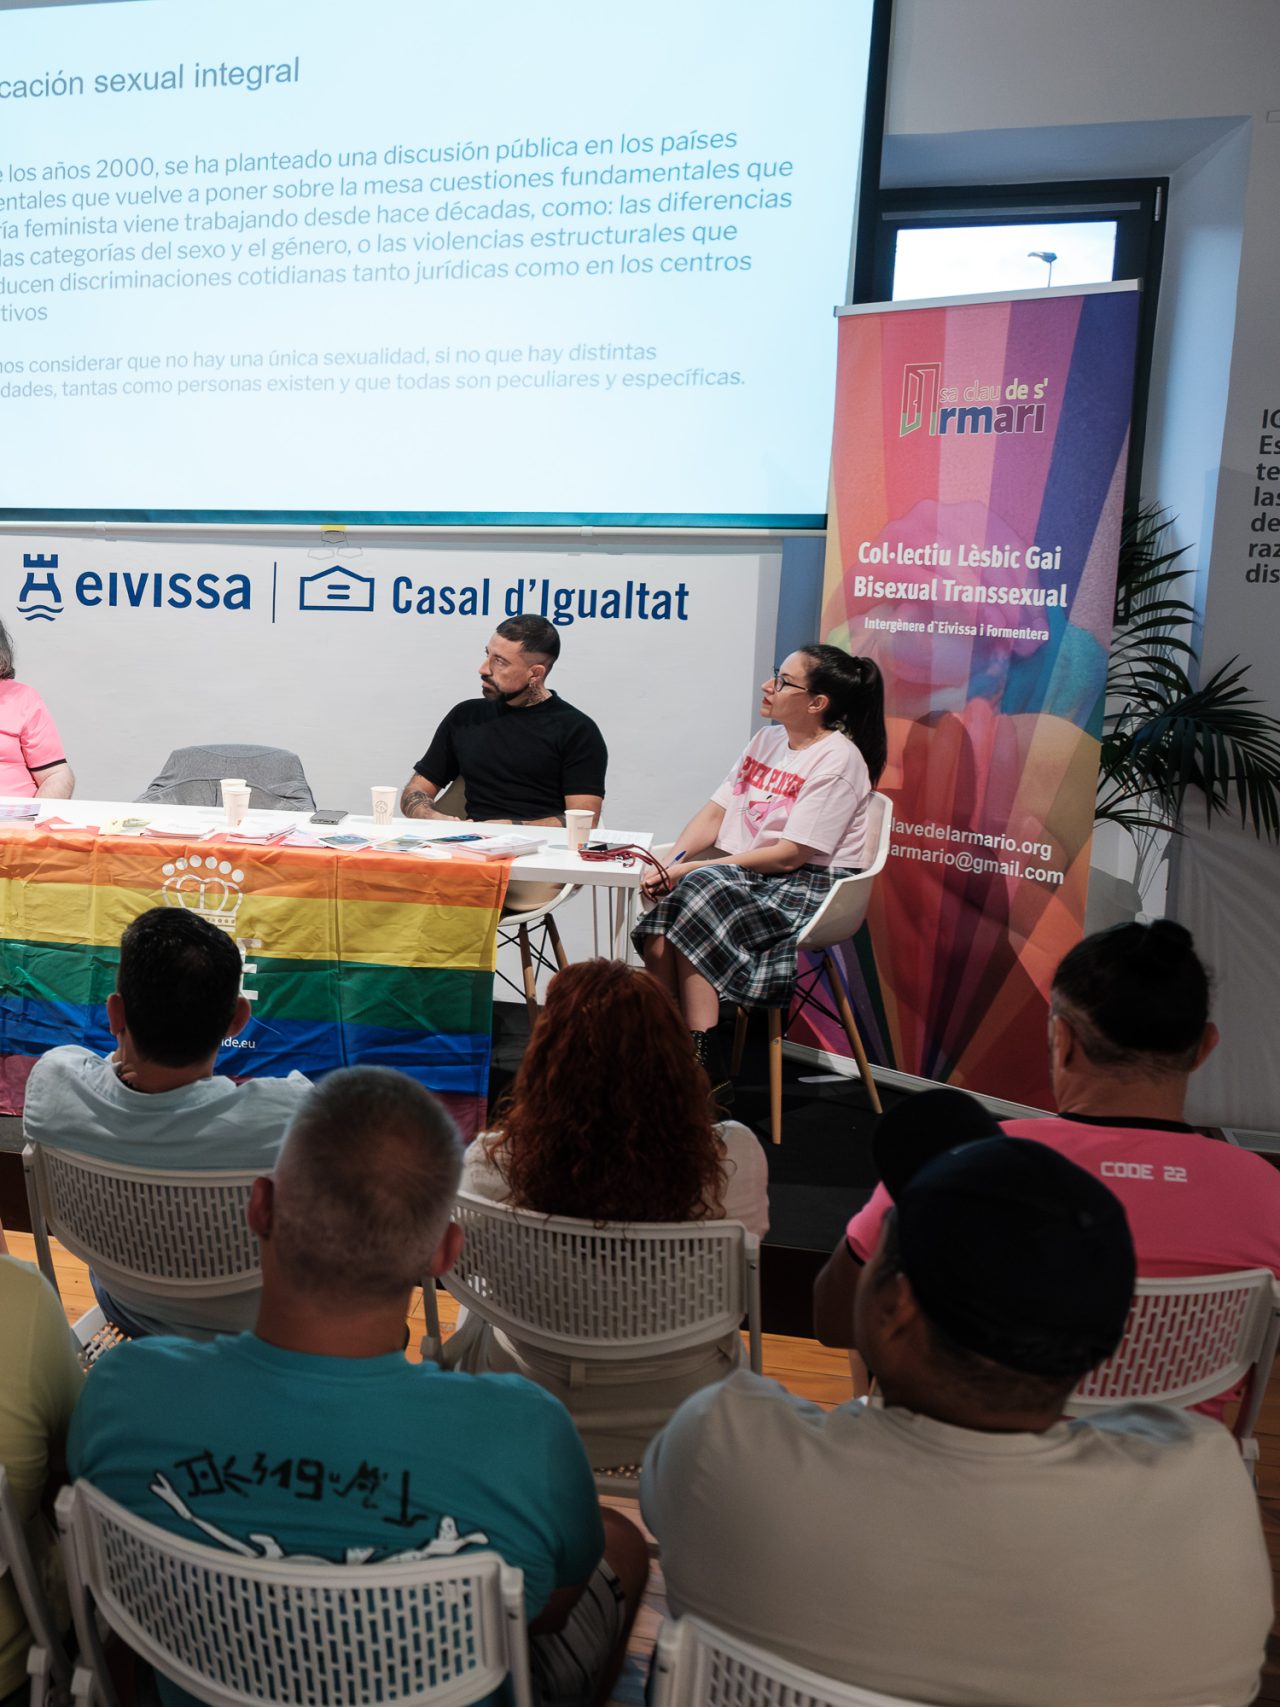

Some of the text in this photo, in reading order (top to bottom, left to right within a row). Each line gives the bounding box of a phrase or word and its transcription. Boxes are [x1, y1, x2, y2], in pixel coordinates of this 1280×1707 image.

[94, 63, 184, 94] sexual
[194, 55, 300, 92] integral
[9, 163, 37, 183] los
[41, 161, 91, 181] años
[96, 156, 160, 179] 2000,
[164, 159, 189, 176] se
[194, 154, 219, 175] ha
[225, 149, 333, 177] planteado
[338, 150, 377, 168] una
[383, 140, 490, 165] discusión
[496, 136, 578, 164] pública
[584, 138, 614, 156] en
[620, 133, 654, 154] los
[660, 129, 738, 157] países
[71, 191, 110, 211] que
[115, 185, 183, 206] vuelve
[187, 187, 200, 203] a
[205, 185, 268, 206] poner
[272, 178, 335, 199] sobre
[340, 176, 358, 197] la
[363, 177, 424, 195] mesa
[429, 169, 554, 193] cuestiones
[560, 159, 740, 187] fundamentales
[746, 160, 794, 182] que
[23, 216, 118, 238] feminista
[123, 214, 180, 233] viene
[184, 208, 299, 233] trabajando
[303, 205, 371, 227] desde
[377, 204, 430, 225] hace
[435, 199, 536, 222] décadas,
[541, 199, 613, 218] como:
[619, 194, 652, 215] las
[657, 188, 793, 213] diferencias
[29, 242, 136, 267] categorías
[140, 240, 172, 261] del
[176, 243, 226, 260] sexo
[231, 243, 243, 262] y
[247, 237, 266, 257] el
[271, 236, 352, 261] género,
[357, 238, 372, 254] o
[377, 233, 407, 253] las
[412, 228, 524, 252] violencias
[530, 223, 685, 248] estructurales
[691, 224, 738, 245] que
[59, 268, 232, 292] discriminaciones
[237, 265, 347, 286] cotidianas
[352, 263, 411, 283] tanto
[413, 259, 509, 285] jurídicas
[514, 260, 580, 278] como
[585, 259, 614, 276] en
[620, 254, 654, 274] los
[659, 252, 752, 273] centros
[28, 355, 124, 373] considerar
[127, 355, 161, 373] que
[165, 354, 189, 369] no
[193, 351, 226, 371] hay
[230, 353, 264, 368] una
[268, 349, 319, 367] única
[323, 346, 430, 366] sexualidad,
[434, 346, 451, 364] si
[455, 349, 481, 364] no
[485, 348, 523, 367] que
[528, 344, 564, 365] hay
[568, 342, 657, 362] distintas
[61, 380, 118, 397] tantas
[122, 380, 173, 395] como
[177, 378, 262, 396] personas
[266, 375, 335, 392] existen
[339, 377, 351, 394] y
[354, 376, 391, 394] que
[396, 372, 451, 391] todas
[455, 375, 491, 390] son
[496, 369, 601, 391] peculiares
[604, 373, 617, 391] y
[621, 367, 745, 390] específicas.
[939, 386, 959, 403] sa
[963, 379, 1001, 401] clau
[1005, 377, 1029, 400] de
[957, 543, 1021, 569] Lèsbic
[1025, 545, 1062, 570] Gai
[75, 570, 251, 610] eivissa
[392, 575, 690, 627] Casal d'Igualtat
[853, 575, 1068, 608] Bisexual Transsexual
[864, 616, 925, 634] Intergènere
[979, 623, 984, 637] i
[986, 624, 1050, 641] Formentera
[890, 817, 1052, 862] lavedelarmario.org
[887, 840, 1065, 885] armario@gmail.com
[1100, 1161, 1188, 1183] CODE 22
